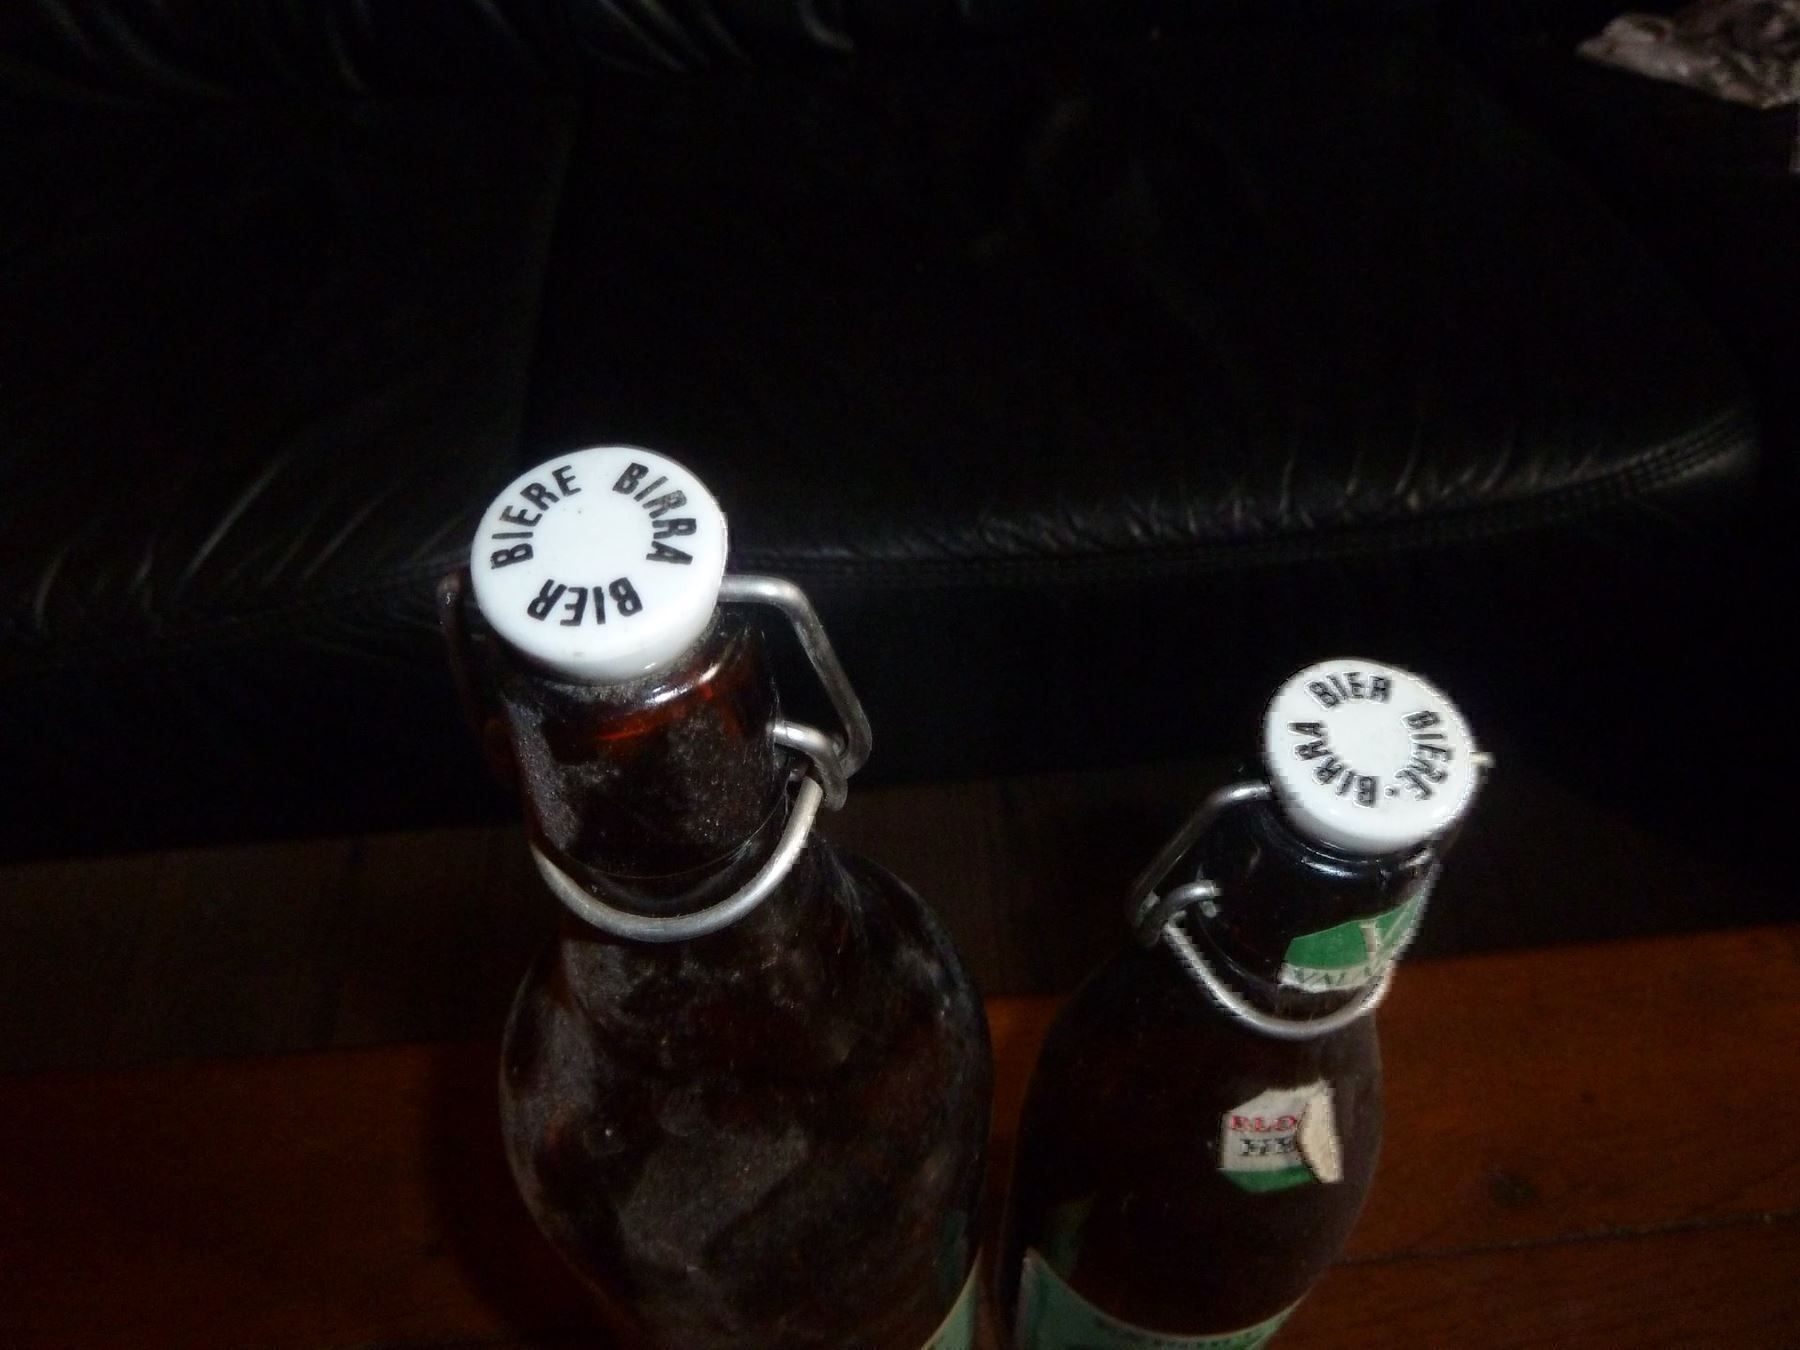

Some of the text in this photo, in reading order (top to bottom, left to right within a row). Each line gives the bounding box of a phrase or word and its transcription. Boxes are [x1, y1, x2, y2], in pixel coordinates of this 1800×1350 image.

[490, 465, 581, 569] BIERE
[612, 462, 697, 565] BIRRA
[527, 577, 643, 626] BIER
[1305, 671, 1391, 709] BIER
[1287, 721, 1377, 808] BIRRA
[1401, 710, 1449, 801] BIERE
